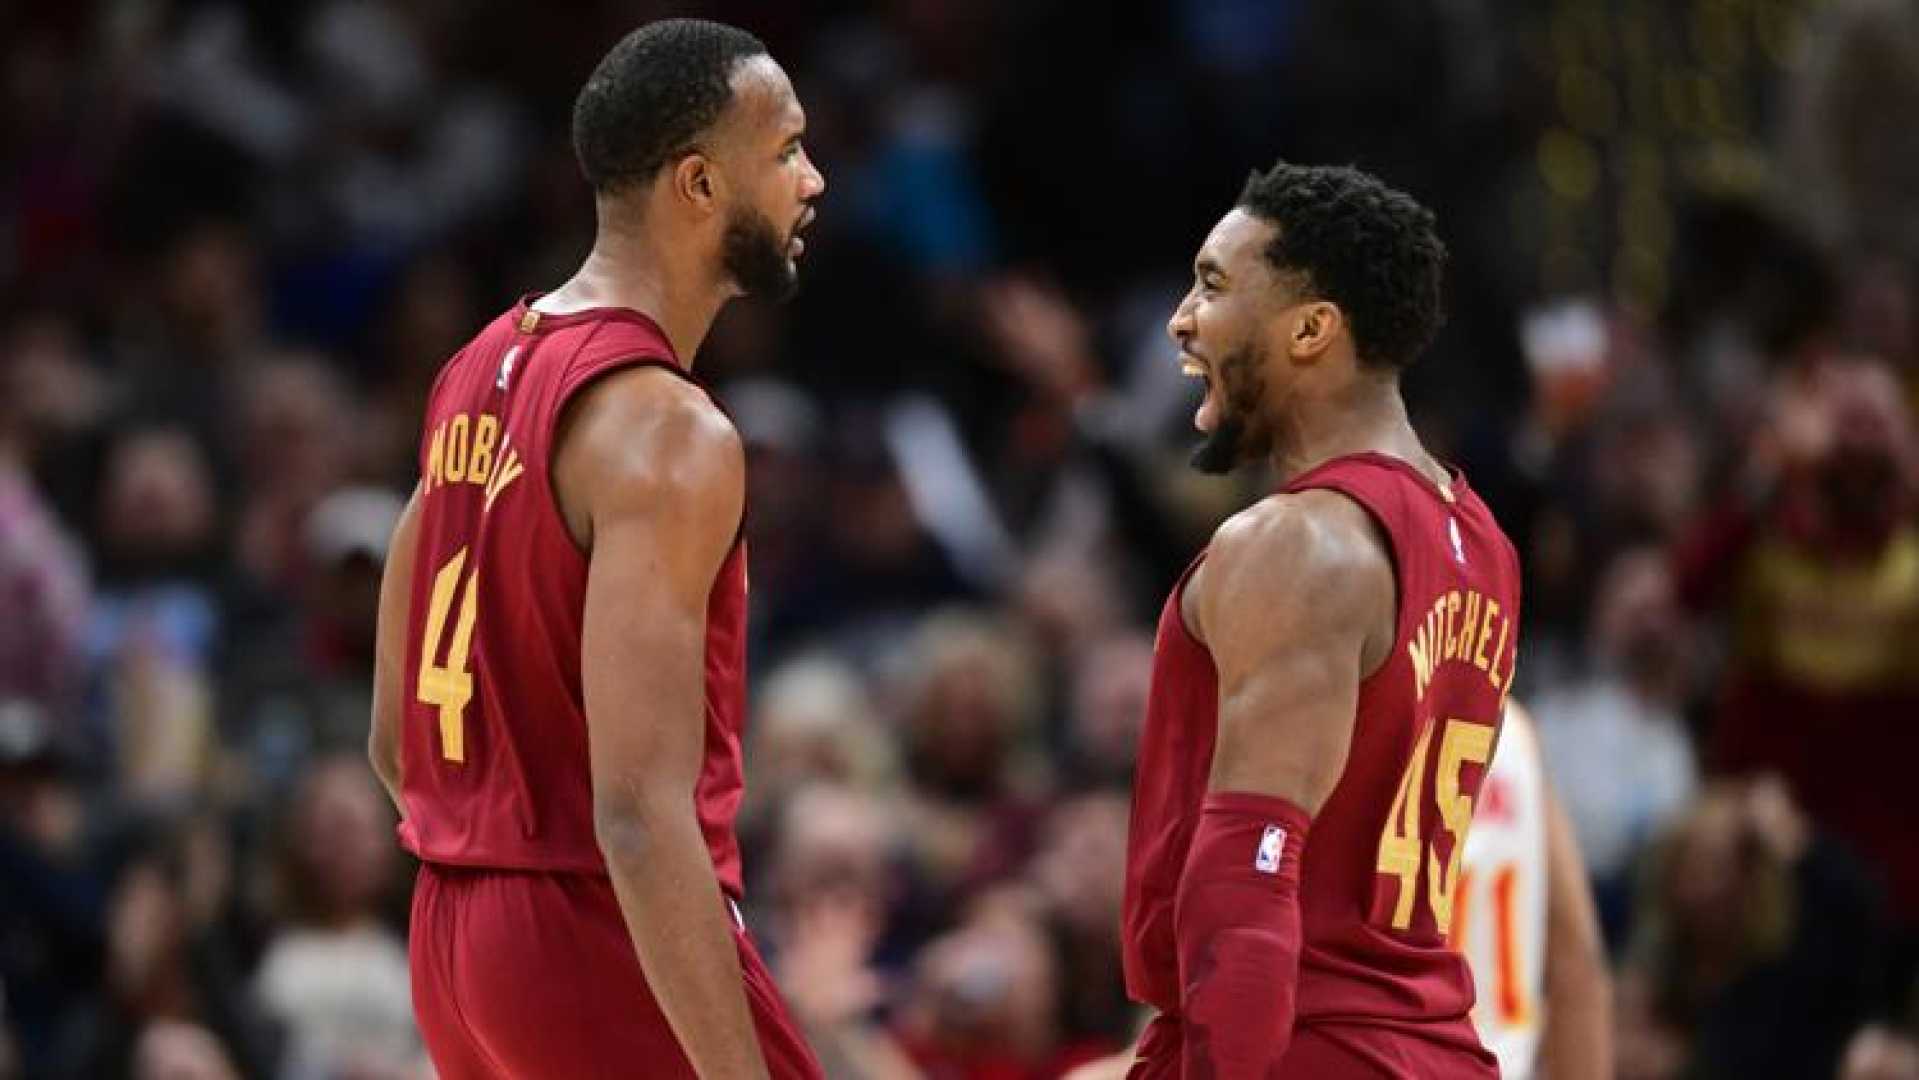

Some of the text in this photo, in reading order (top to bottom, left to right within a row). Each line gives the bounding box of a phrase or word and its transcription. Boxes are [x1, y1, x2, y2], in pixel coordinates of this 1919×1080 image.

[424, 413, 524, 512] MOBY
[417, 546, 479, 761] 4
[1376, 718, 1496, 934] 45
